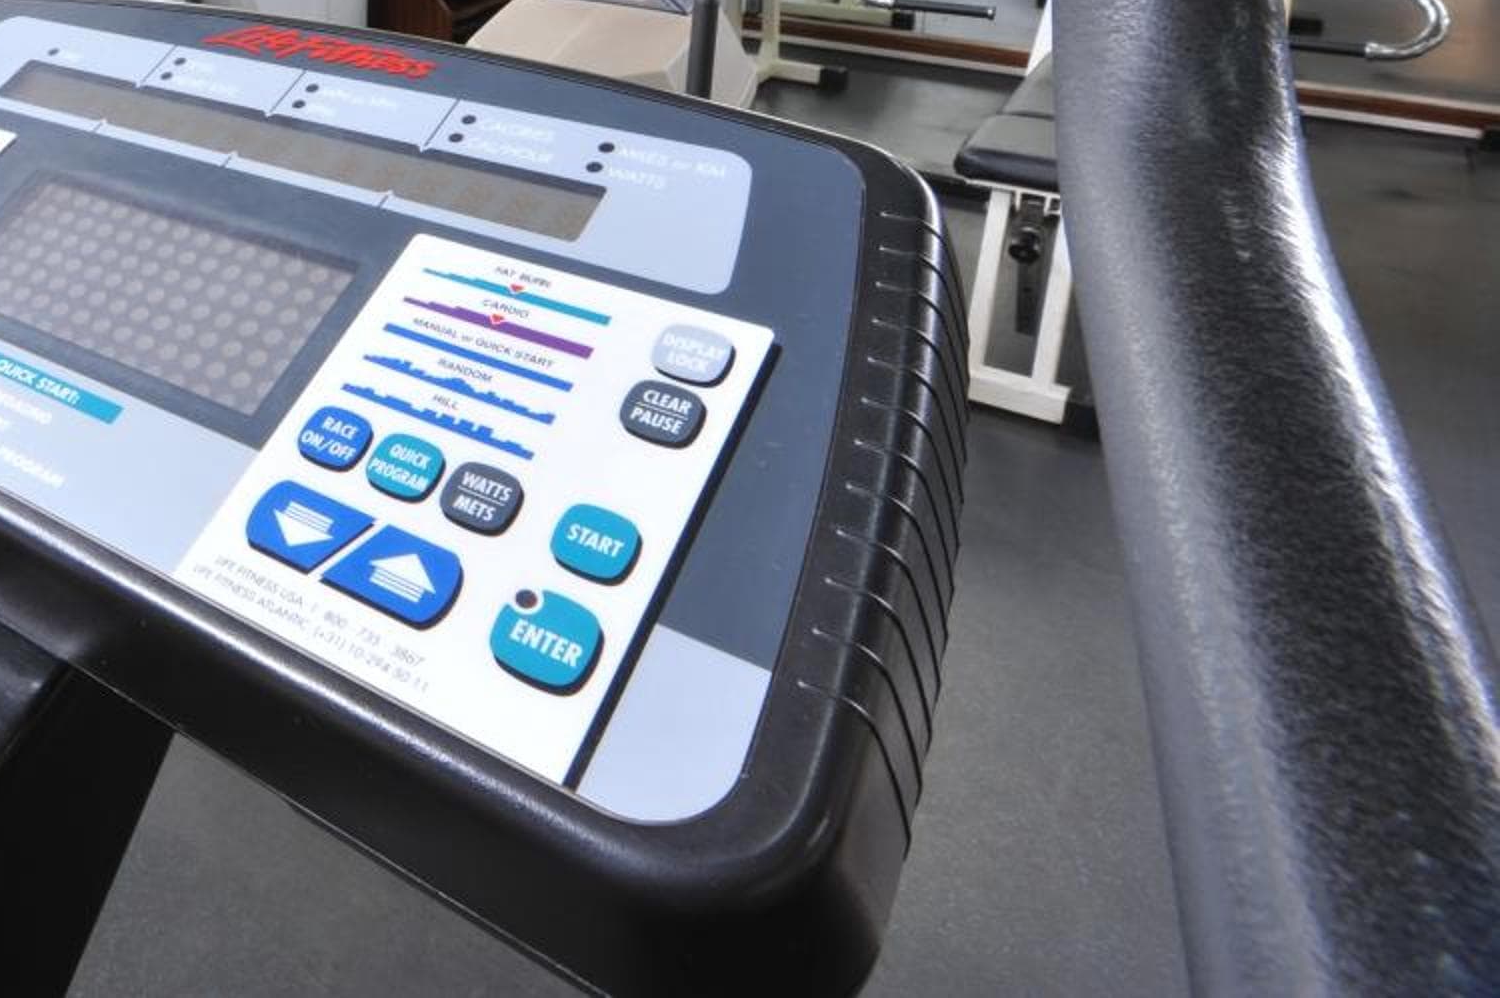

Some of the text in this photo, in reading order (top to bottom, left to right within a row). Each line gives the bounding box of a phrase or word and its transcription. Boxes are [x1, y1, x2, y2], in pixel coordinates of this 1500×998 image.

[482, 299, 530, 319] CARDIO
[413, 318, 458, 338] MANUAL
[475, 336, 512, 356] QUICK
[514, 349, 555, 369] START
[438, 358, 493, 383] RANDOM
[432, 393, 459, 410] HILL
[642, 388, 694, 416] CLEAR
[320, 415, 360, 440] RACE
[629, 406, 686, 435] PAUSE
[300, 429, 358, 461] ON/OFF
[388, 442, 432, 470] QUICK
[367, 456, 430, 493] PROGRAM
[461, 470, 513, 503] WATTS
[452, 494, 498, 522] METS
[566, 523, 626, 558] START
[509, 618, 583, 668] ENTER
